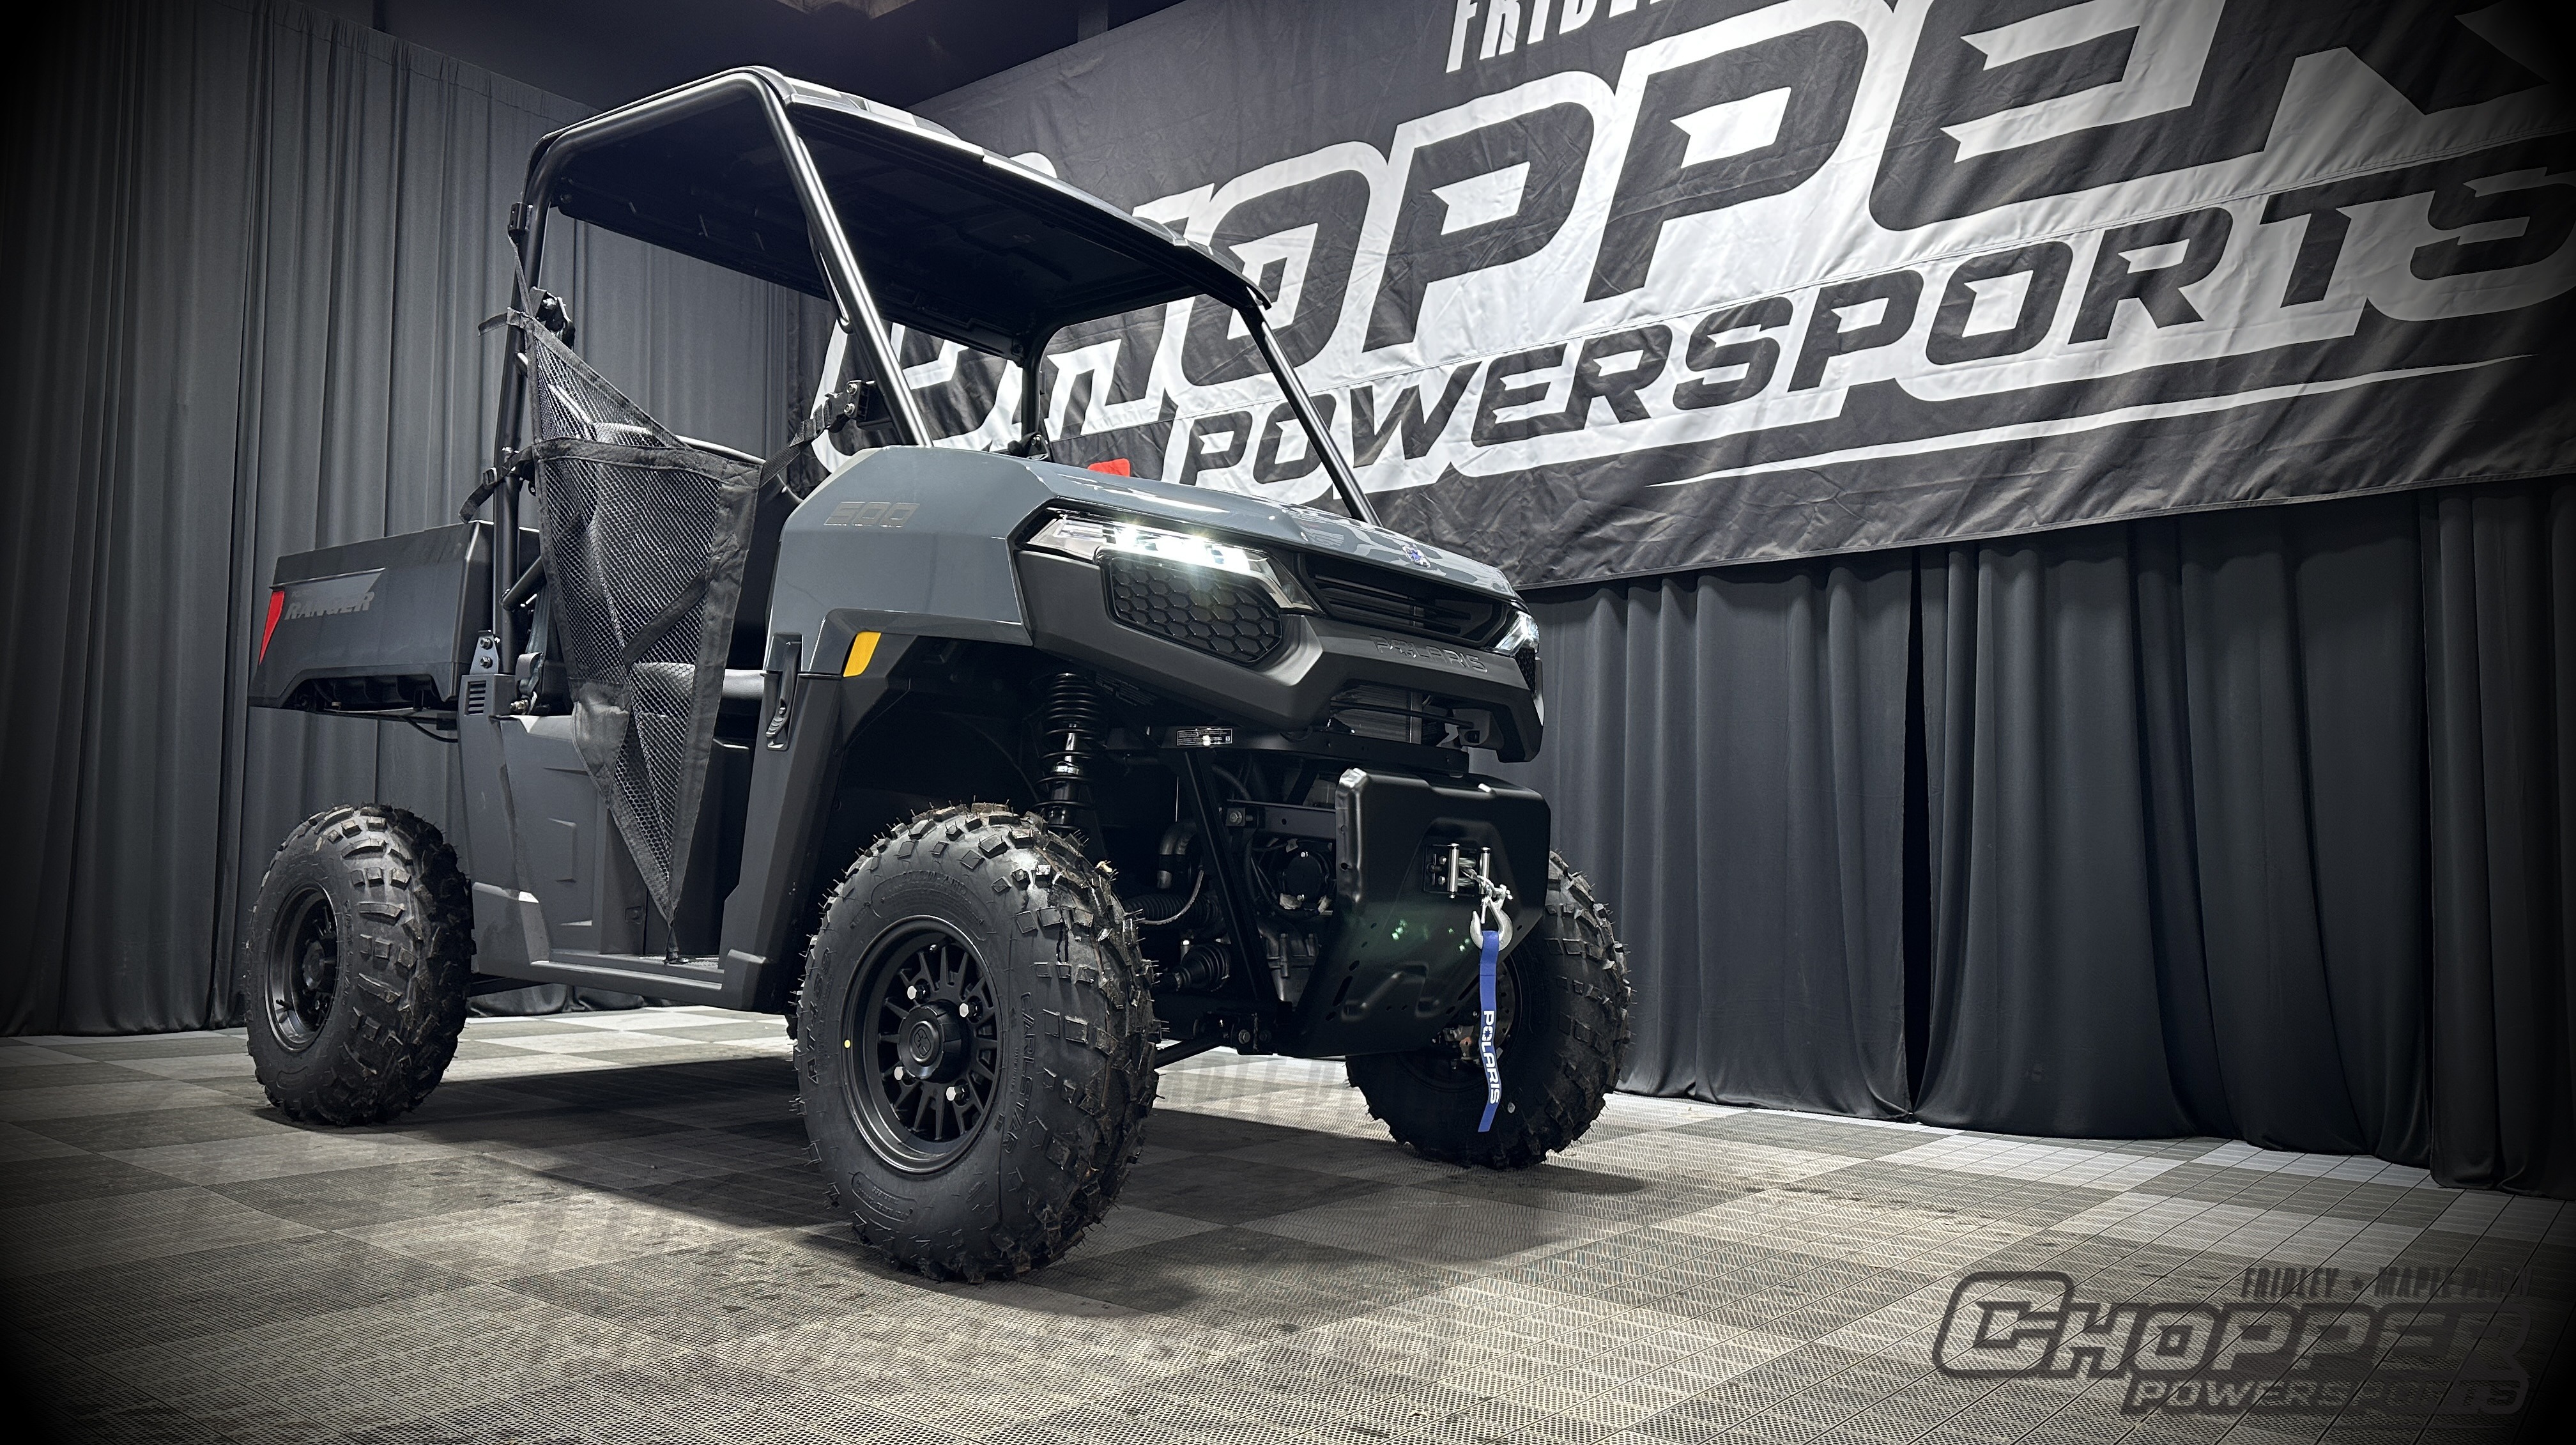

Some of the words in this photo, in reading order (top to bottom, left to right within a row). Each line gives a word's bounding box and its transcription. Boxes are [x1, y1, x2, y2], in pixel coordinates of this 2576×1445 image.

[1179, 131, 2575, 484] POWERSPORTS
[824, 502, 920, 527] 500
[284, 591, 374, 620] RANGER
[1370, 635, 1487, 672] POLARIS
[1003, 993, 1034, 1154] CARLSTAR
[1481, 1010, 1500, 1104] POLARIS
